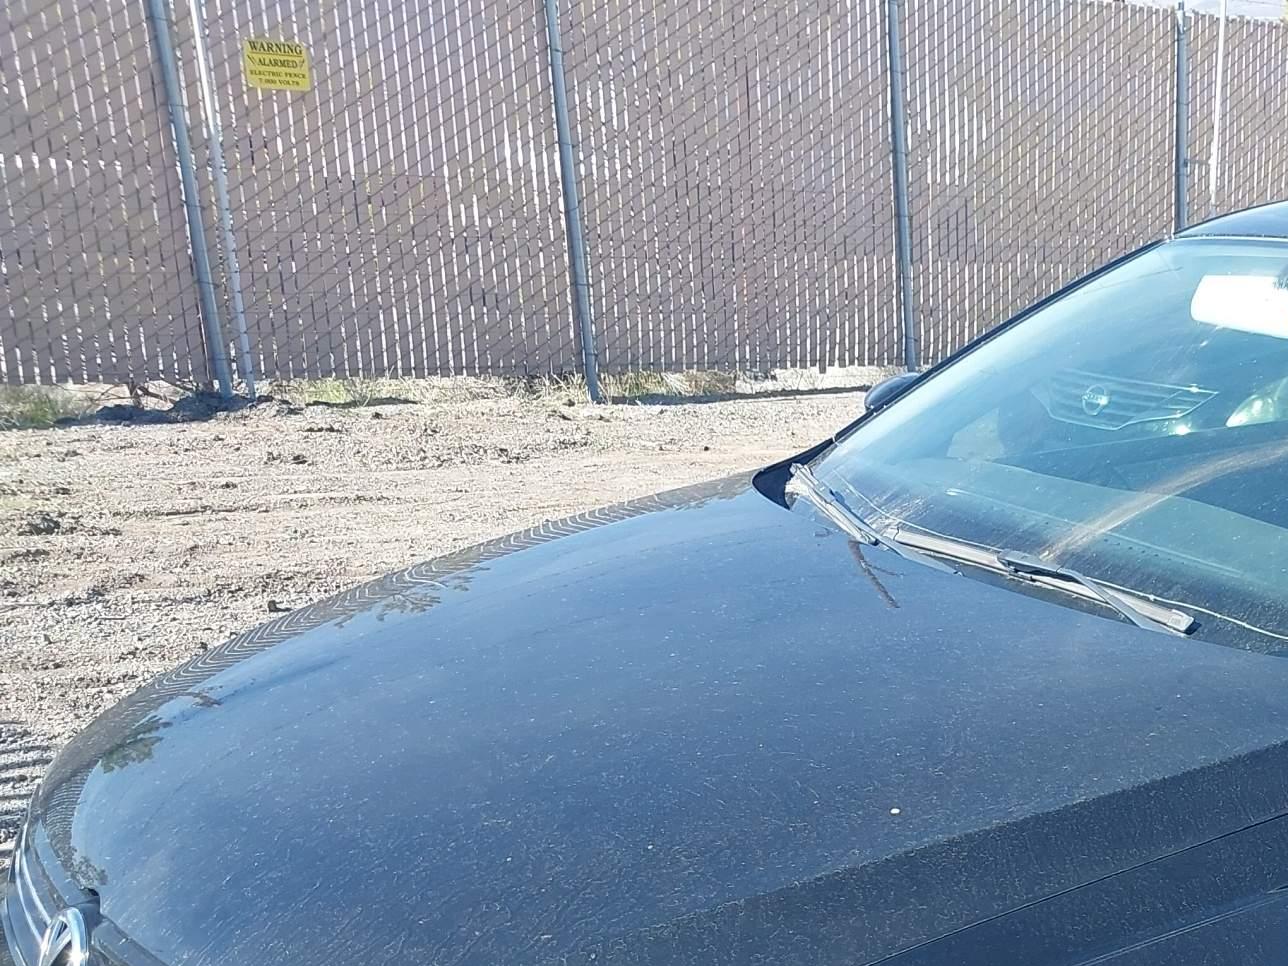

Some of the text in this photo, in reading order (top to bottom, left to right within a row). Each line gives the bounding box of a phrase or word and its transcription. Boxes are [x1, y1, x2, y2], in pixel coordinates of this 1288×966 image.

[248, 40, 303, 55] WARNING
[257, 56, 298, 69] ALARMED
[250, 69, 283, 78] ELECTRIC
